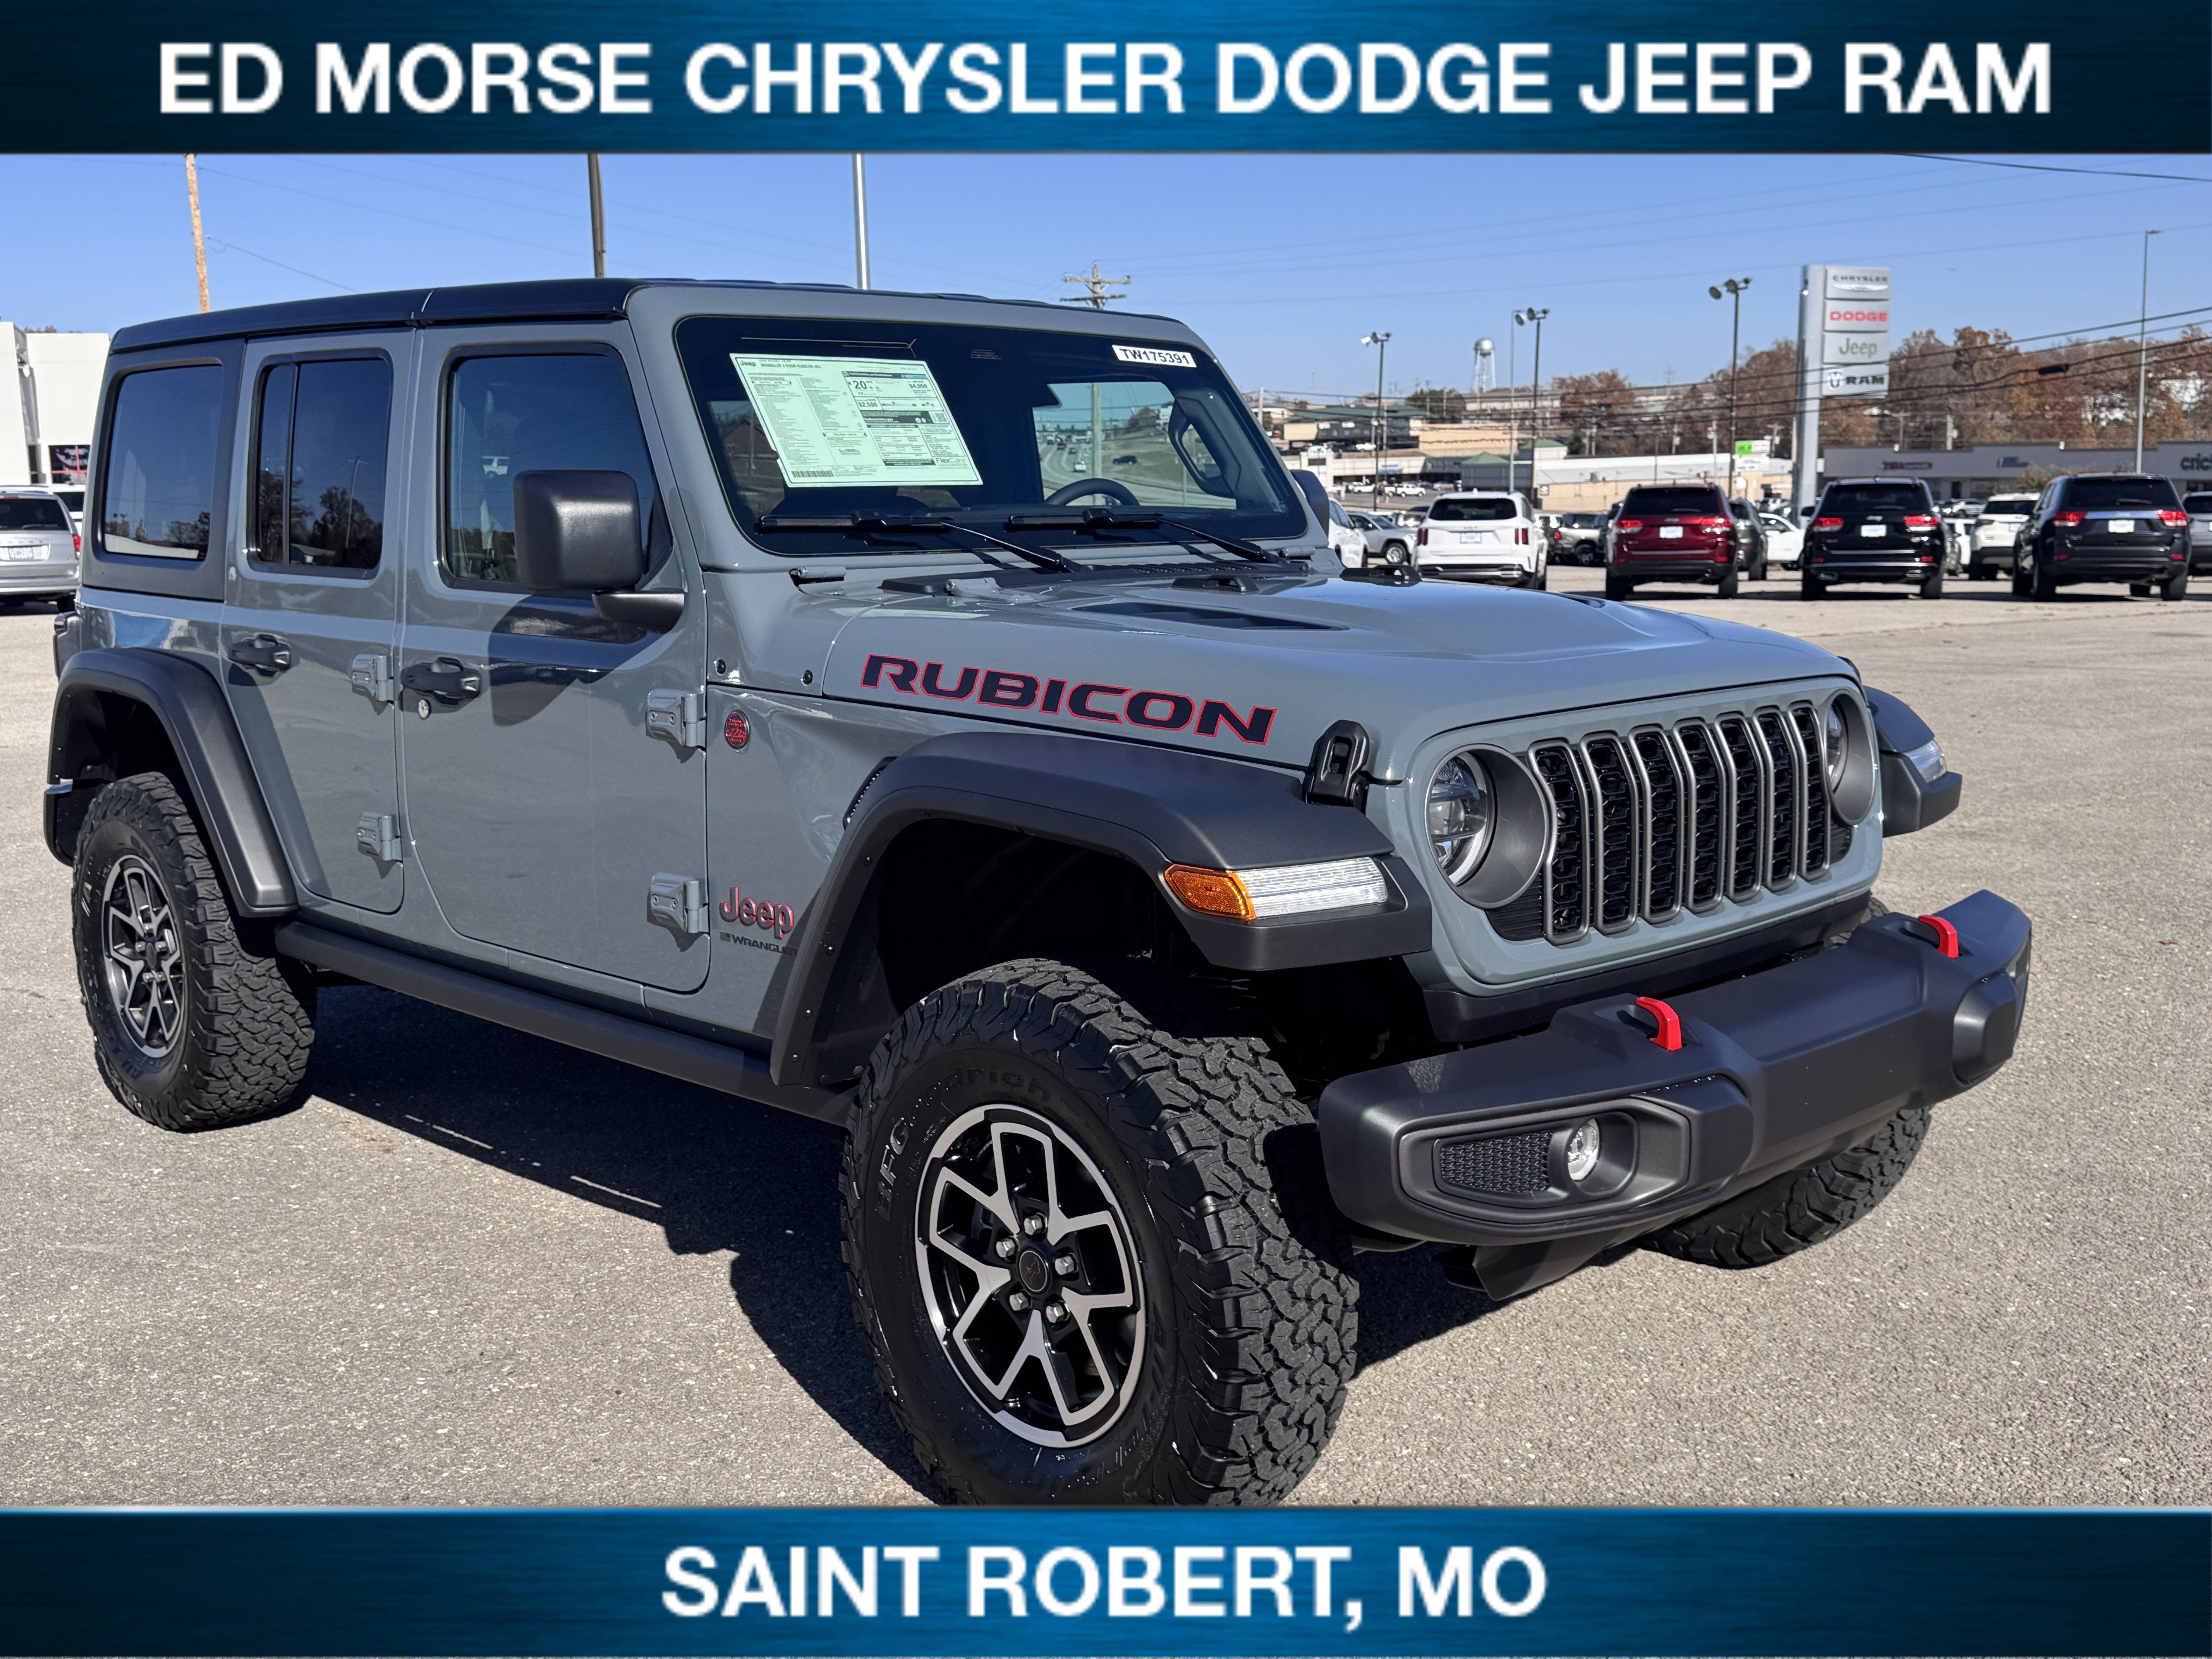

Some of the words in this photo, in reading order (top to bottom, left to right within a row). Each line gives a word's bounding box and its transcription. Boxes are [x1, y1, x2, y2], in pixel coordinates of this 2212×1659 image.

[1832, 273, 1888, 283] CHRYSLER
[1830, 310, 1888, 322] DODGE
[1839, 337, 1877, 357] Jeep
[1119, 348, 1190, 364] TW175391
[853, 380, 867, 389] 20
[1846, 375, 1884, 385] RAM
[2181, 452, 2212, 471] cric
[860, 654, 1278, 744] RUBICON
[719, 884, 795, 940] Jeep
